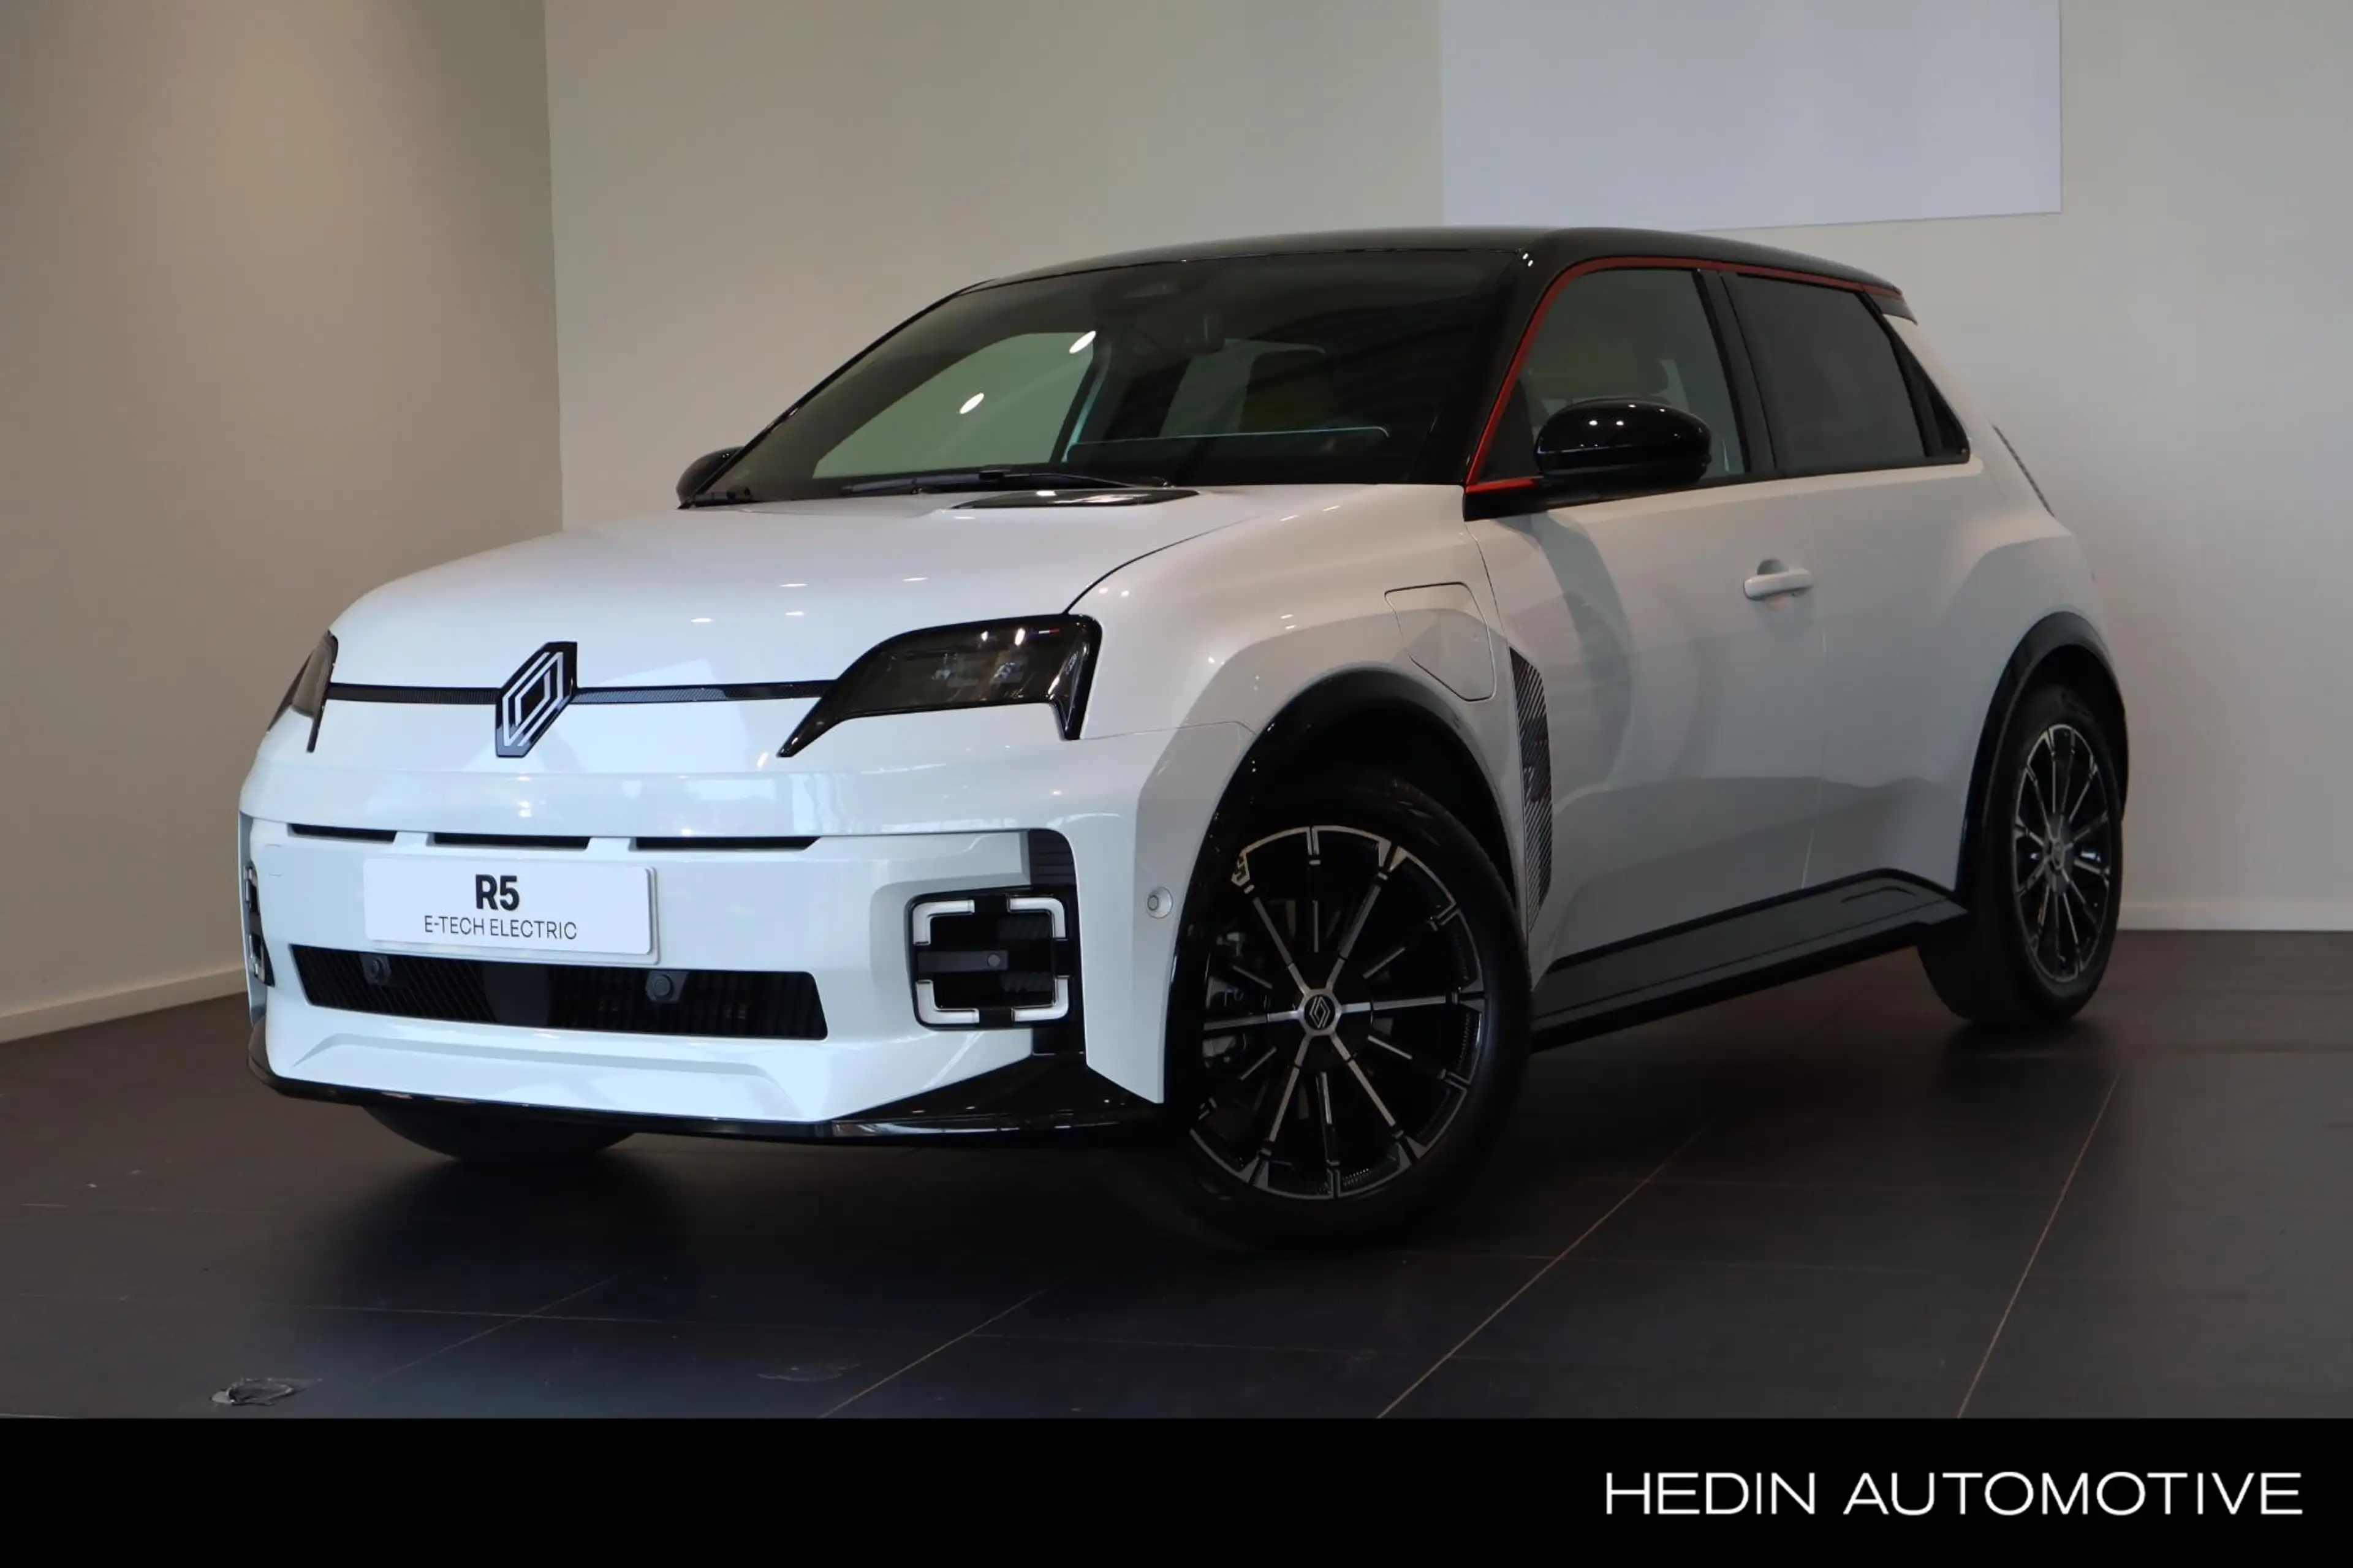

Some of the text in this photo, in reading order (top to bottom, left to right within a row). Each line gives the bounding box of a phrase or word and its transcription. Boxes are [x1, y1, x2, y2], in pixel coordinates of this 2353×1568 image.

[476, 874, 520, 911] R5
[424, 915, 577, 940] E-TECH ELECTRIC
